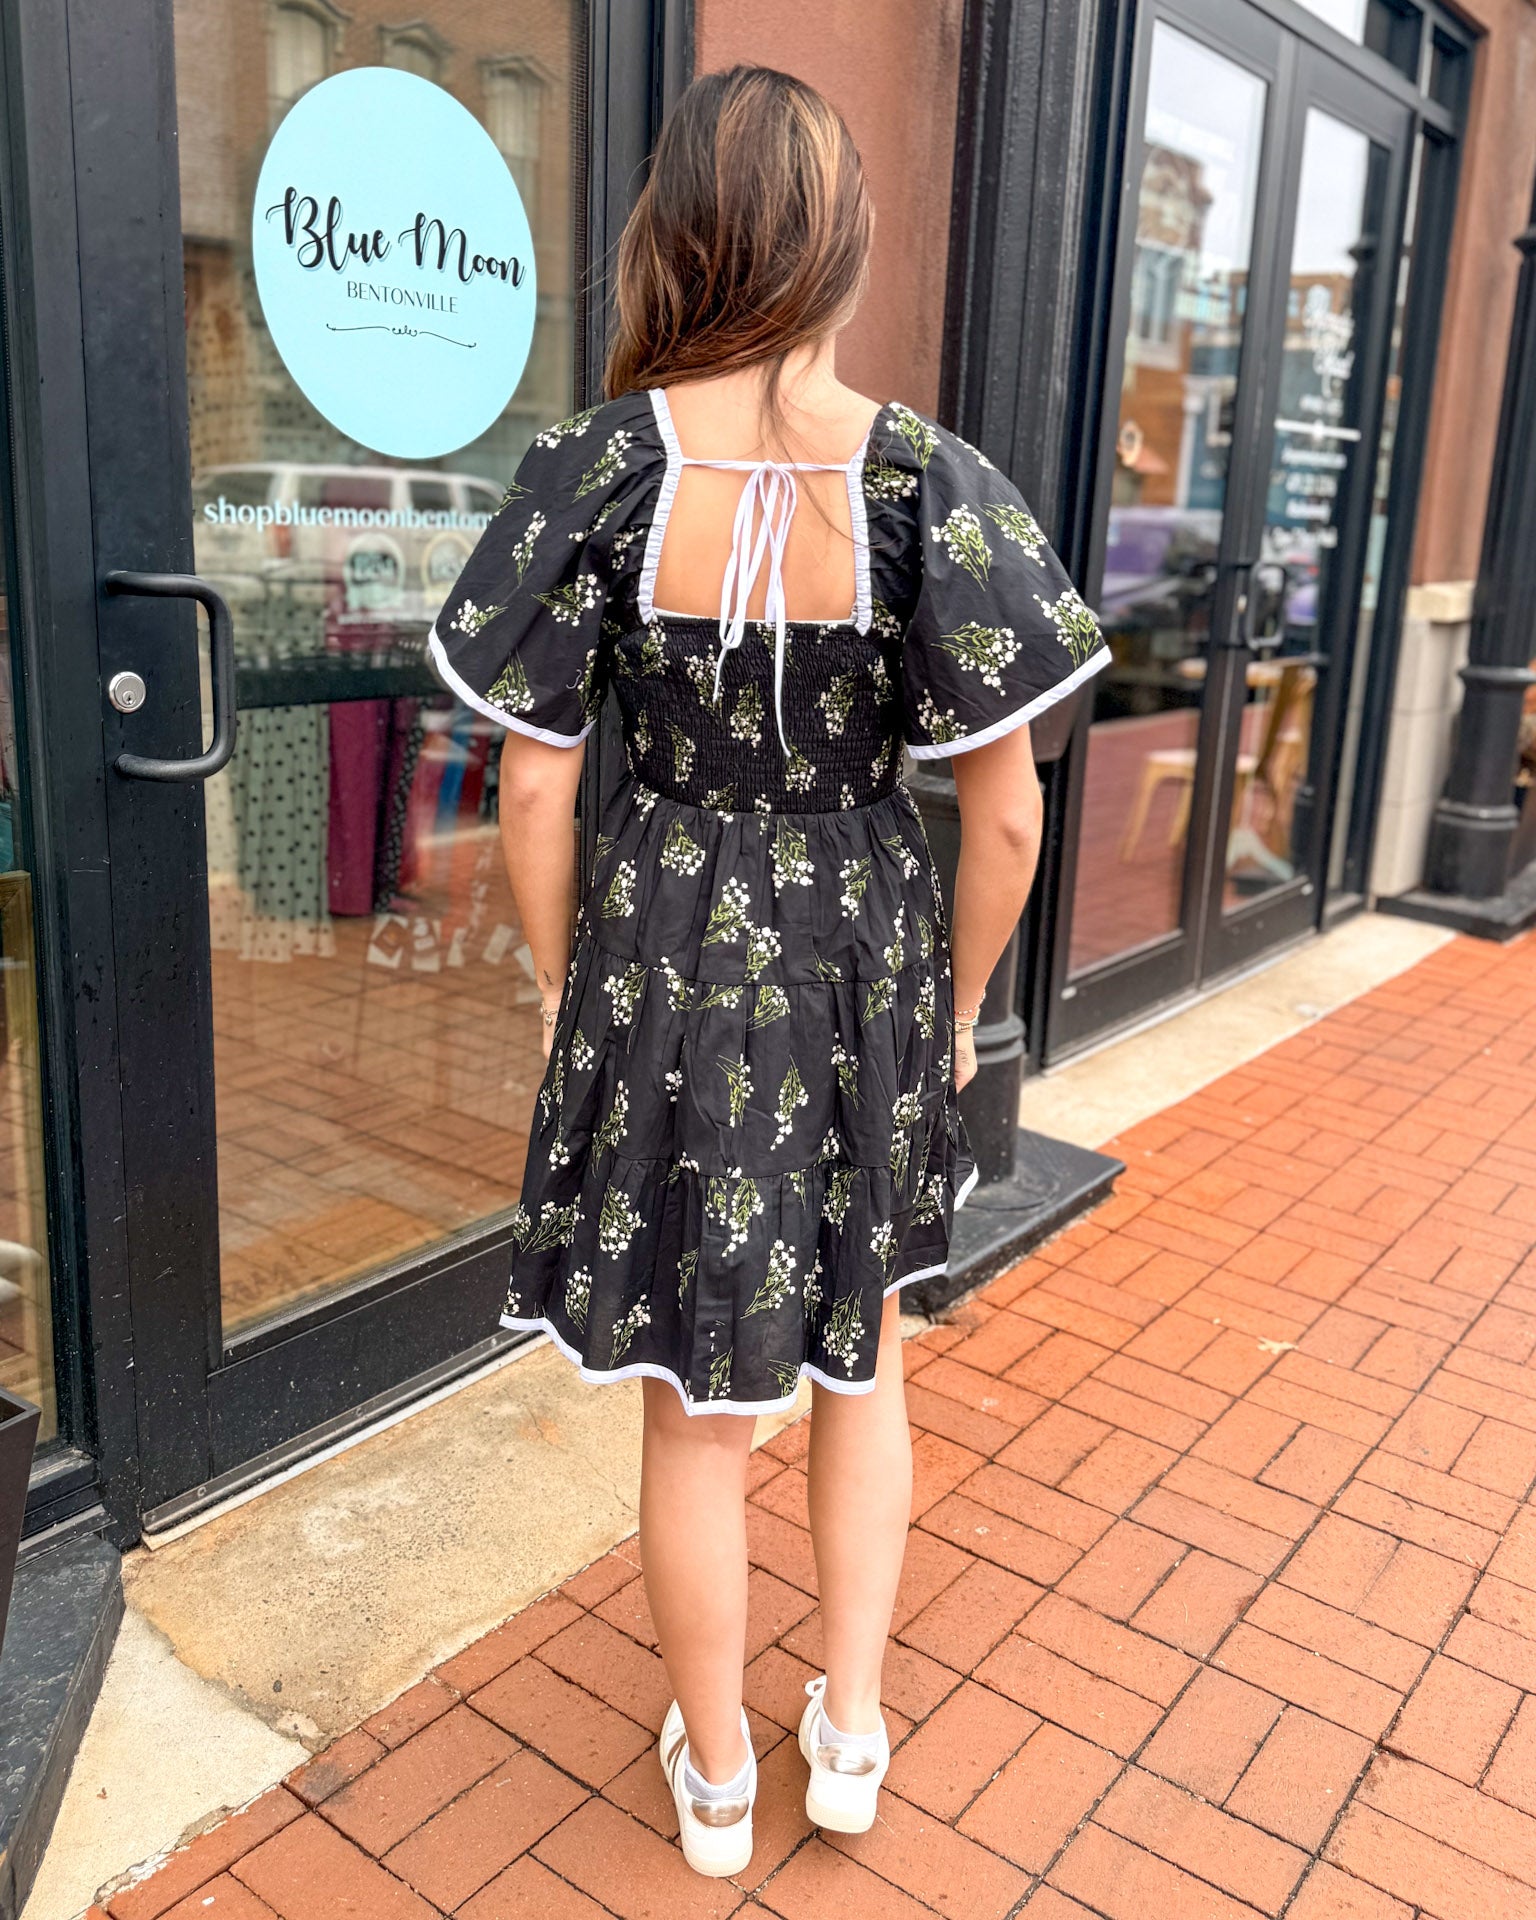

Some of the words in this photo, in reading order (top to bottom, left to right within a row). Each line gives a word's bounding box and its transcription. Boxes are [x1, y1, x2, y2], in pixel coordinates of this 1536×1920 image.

[265, 186, 391, 272] Blue
[397, 212, 525, 288] Moon
[346, 280, 459, 313] BENTONVILLE
